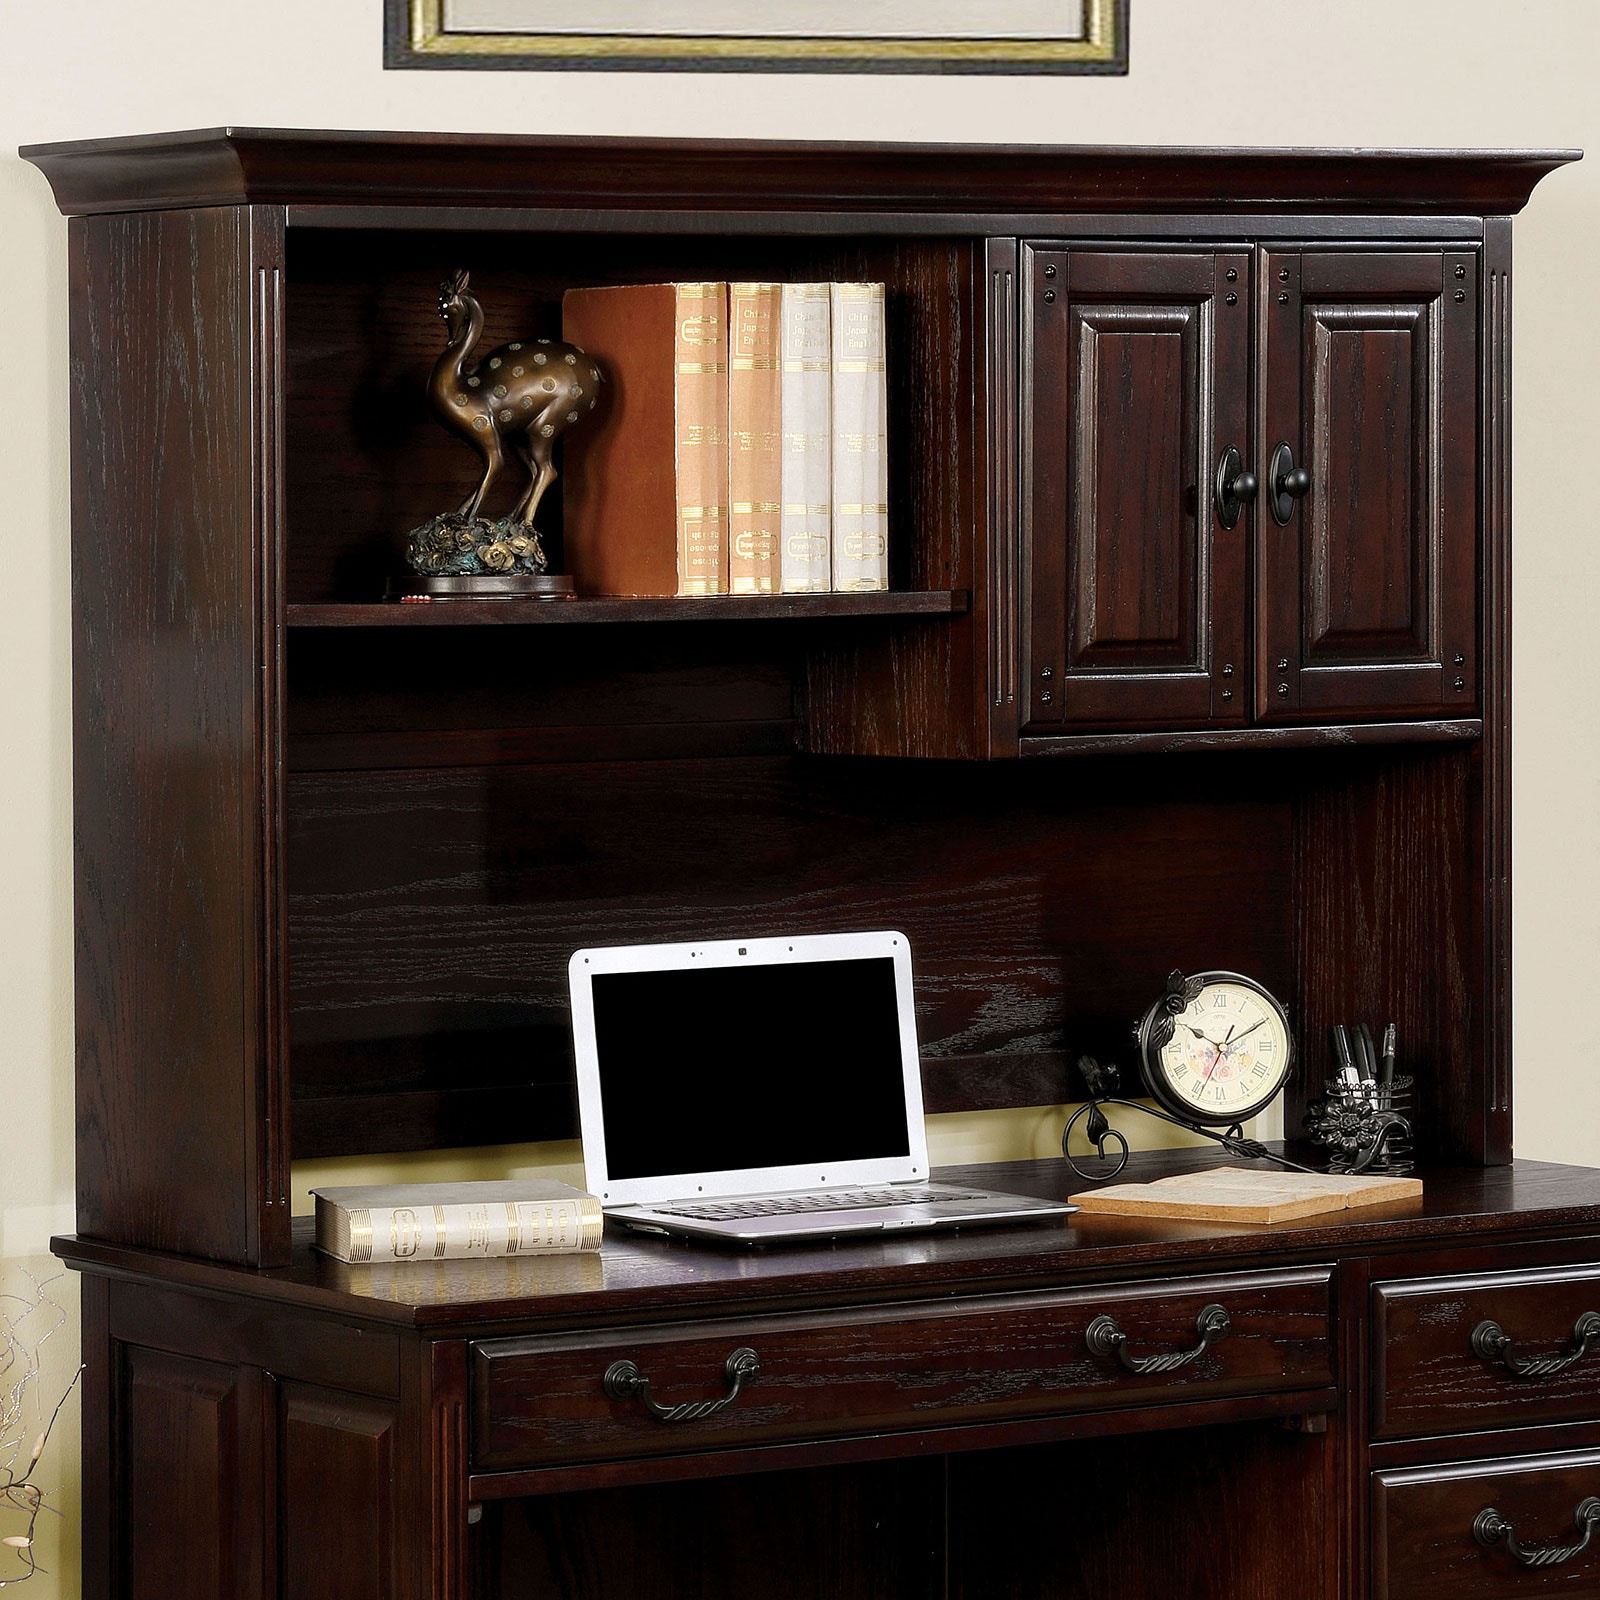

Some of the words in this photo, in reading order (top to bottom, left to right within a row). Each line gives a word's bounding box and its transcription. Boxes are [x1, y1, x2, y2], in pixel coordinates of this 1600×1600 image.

[1191, 1000, 1205, 1015] XI
[1213, 994, 1227, 1008] XII
[1238, 1000, 1247, 1013] I
[1168, 1042, 1181, 1054] IX
[1259, 1041, 1272, 1052] III
[1173, 1063, 1188, 1079] VIII
[1215, 1087, 1226, 1100] VI
[1240, 1081, 1250, 1094] V
